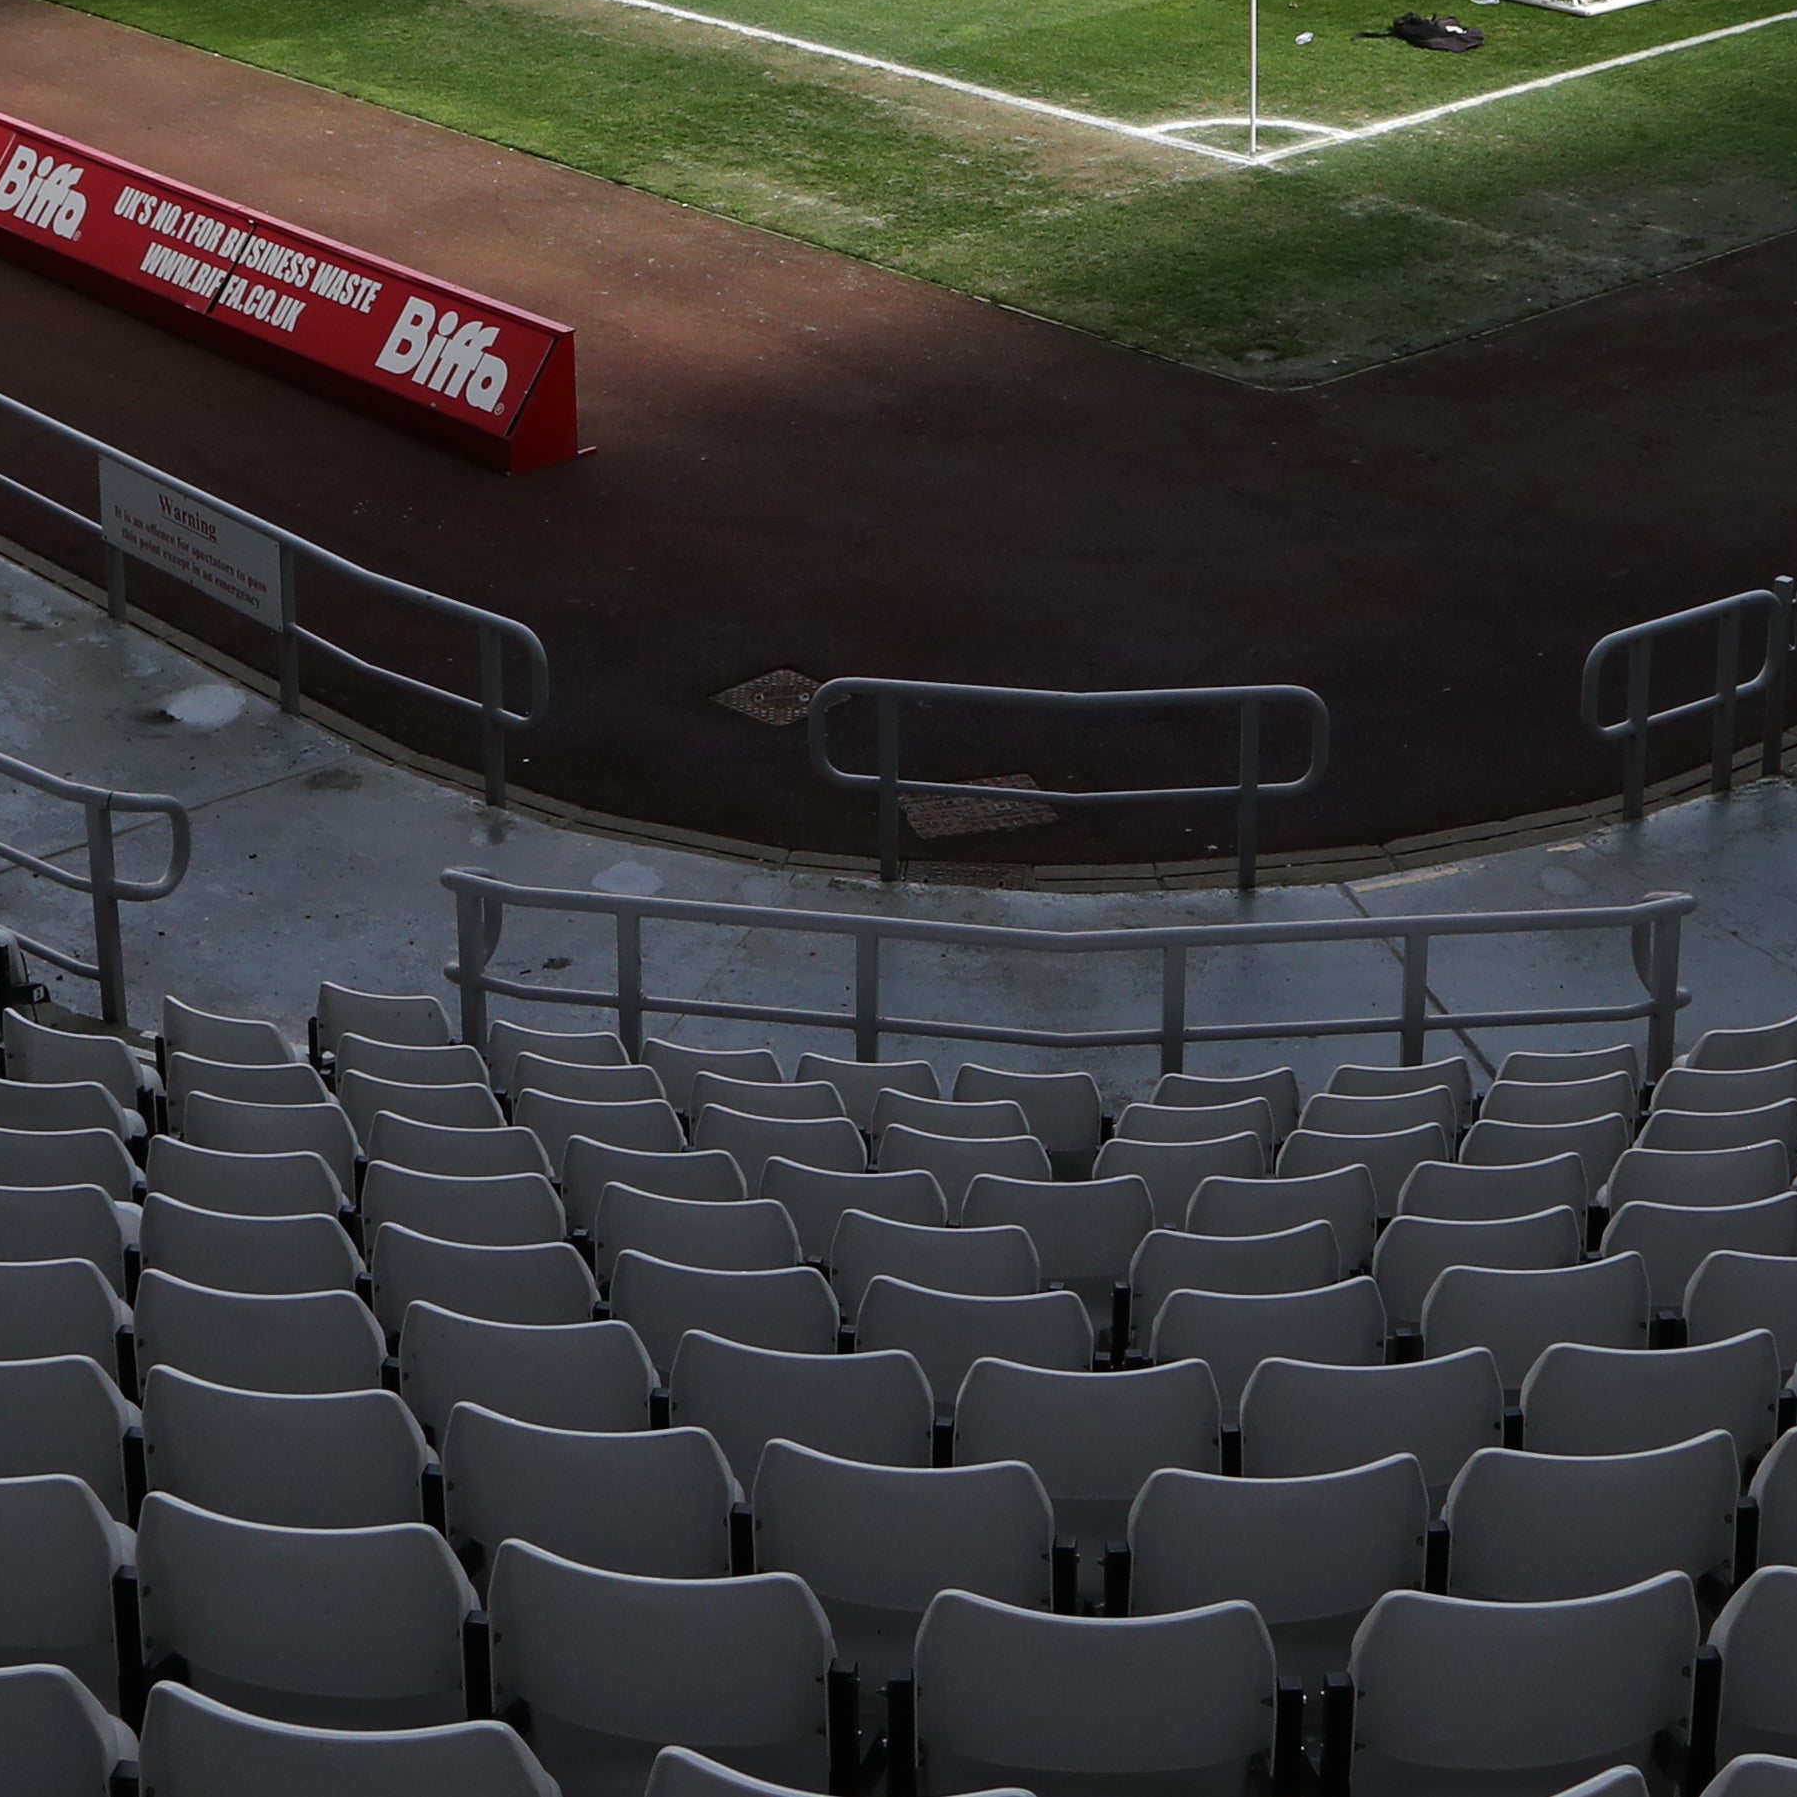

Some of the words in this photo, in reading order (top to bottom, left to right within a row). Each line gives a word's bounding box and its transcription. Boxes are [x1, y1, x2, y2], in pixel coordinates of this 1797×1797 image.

[114, 186, 159, 225] UK'S
[149, 198, 193, 245] NO.1
[185, 214, 223, 252] FOR
[222, 227, 315, 289] BUSINESS
[310, 260, 383, 314] WASTE
[140, 241, 306, 333] WWW.BIFFA.CO.UK
[375, 295, 508, 414] Biffa
[113, 504, 123, 519] It
[123, 509, 132, 522] is
[132, 516, 144, 529] an
[145, 520, 175, 544] offence
[176, 535, 191, 553] for
[191, 547, 235, 578] spectators
[236, 567, 247, 583] to
[247, 575, 268, 596] pass
[158, 493, 218, 544] Warning
[121, 527, 138, 544] this
[139, 536, 161, 557] point
[162, 550, 191, 572] except
[191, 565, 201, 578] in
[202, 570, 214, 584] an
[214, 577, 260, 610] emergency
